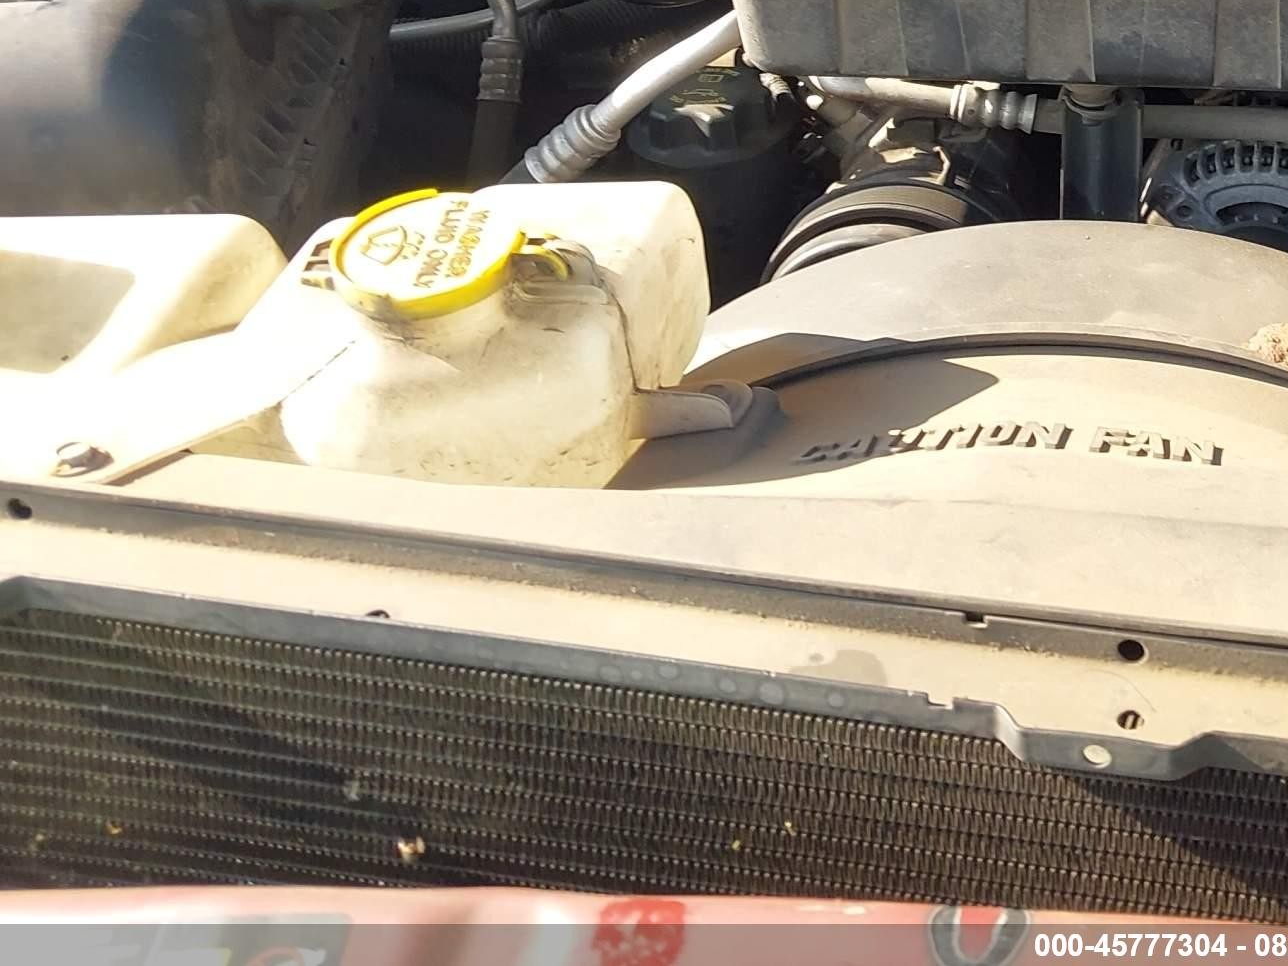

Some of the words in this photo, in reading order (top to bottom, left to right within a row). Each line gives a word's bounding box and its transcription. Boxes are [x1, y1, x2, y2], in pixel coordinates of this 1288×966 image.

[434, 200, 470, 245] FLUID
[445, 209, 492, 278] WASHER
[412, 249, 449, 289] ONLY
[799, 419, 1073, 464] CAUTION
[1089, 425, 1223, 467] FAN
